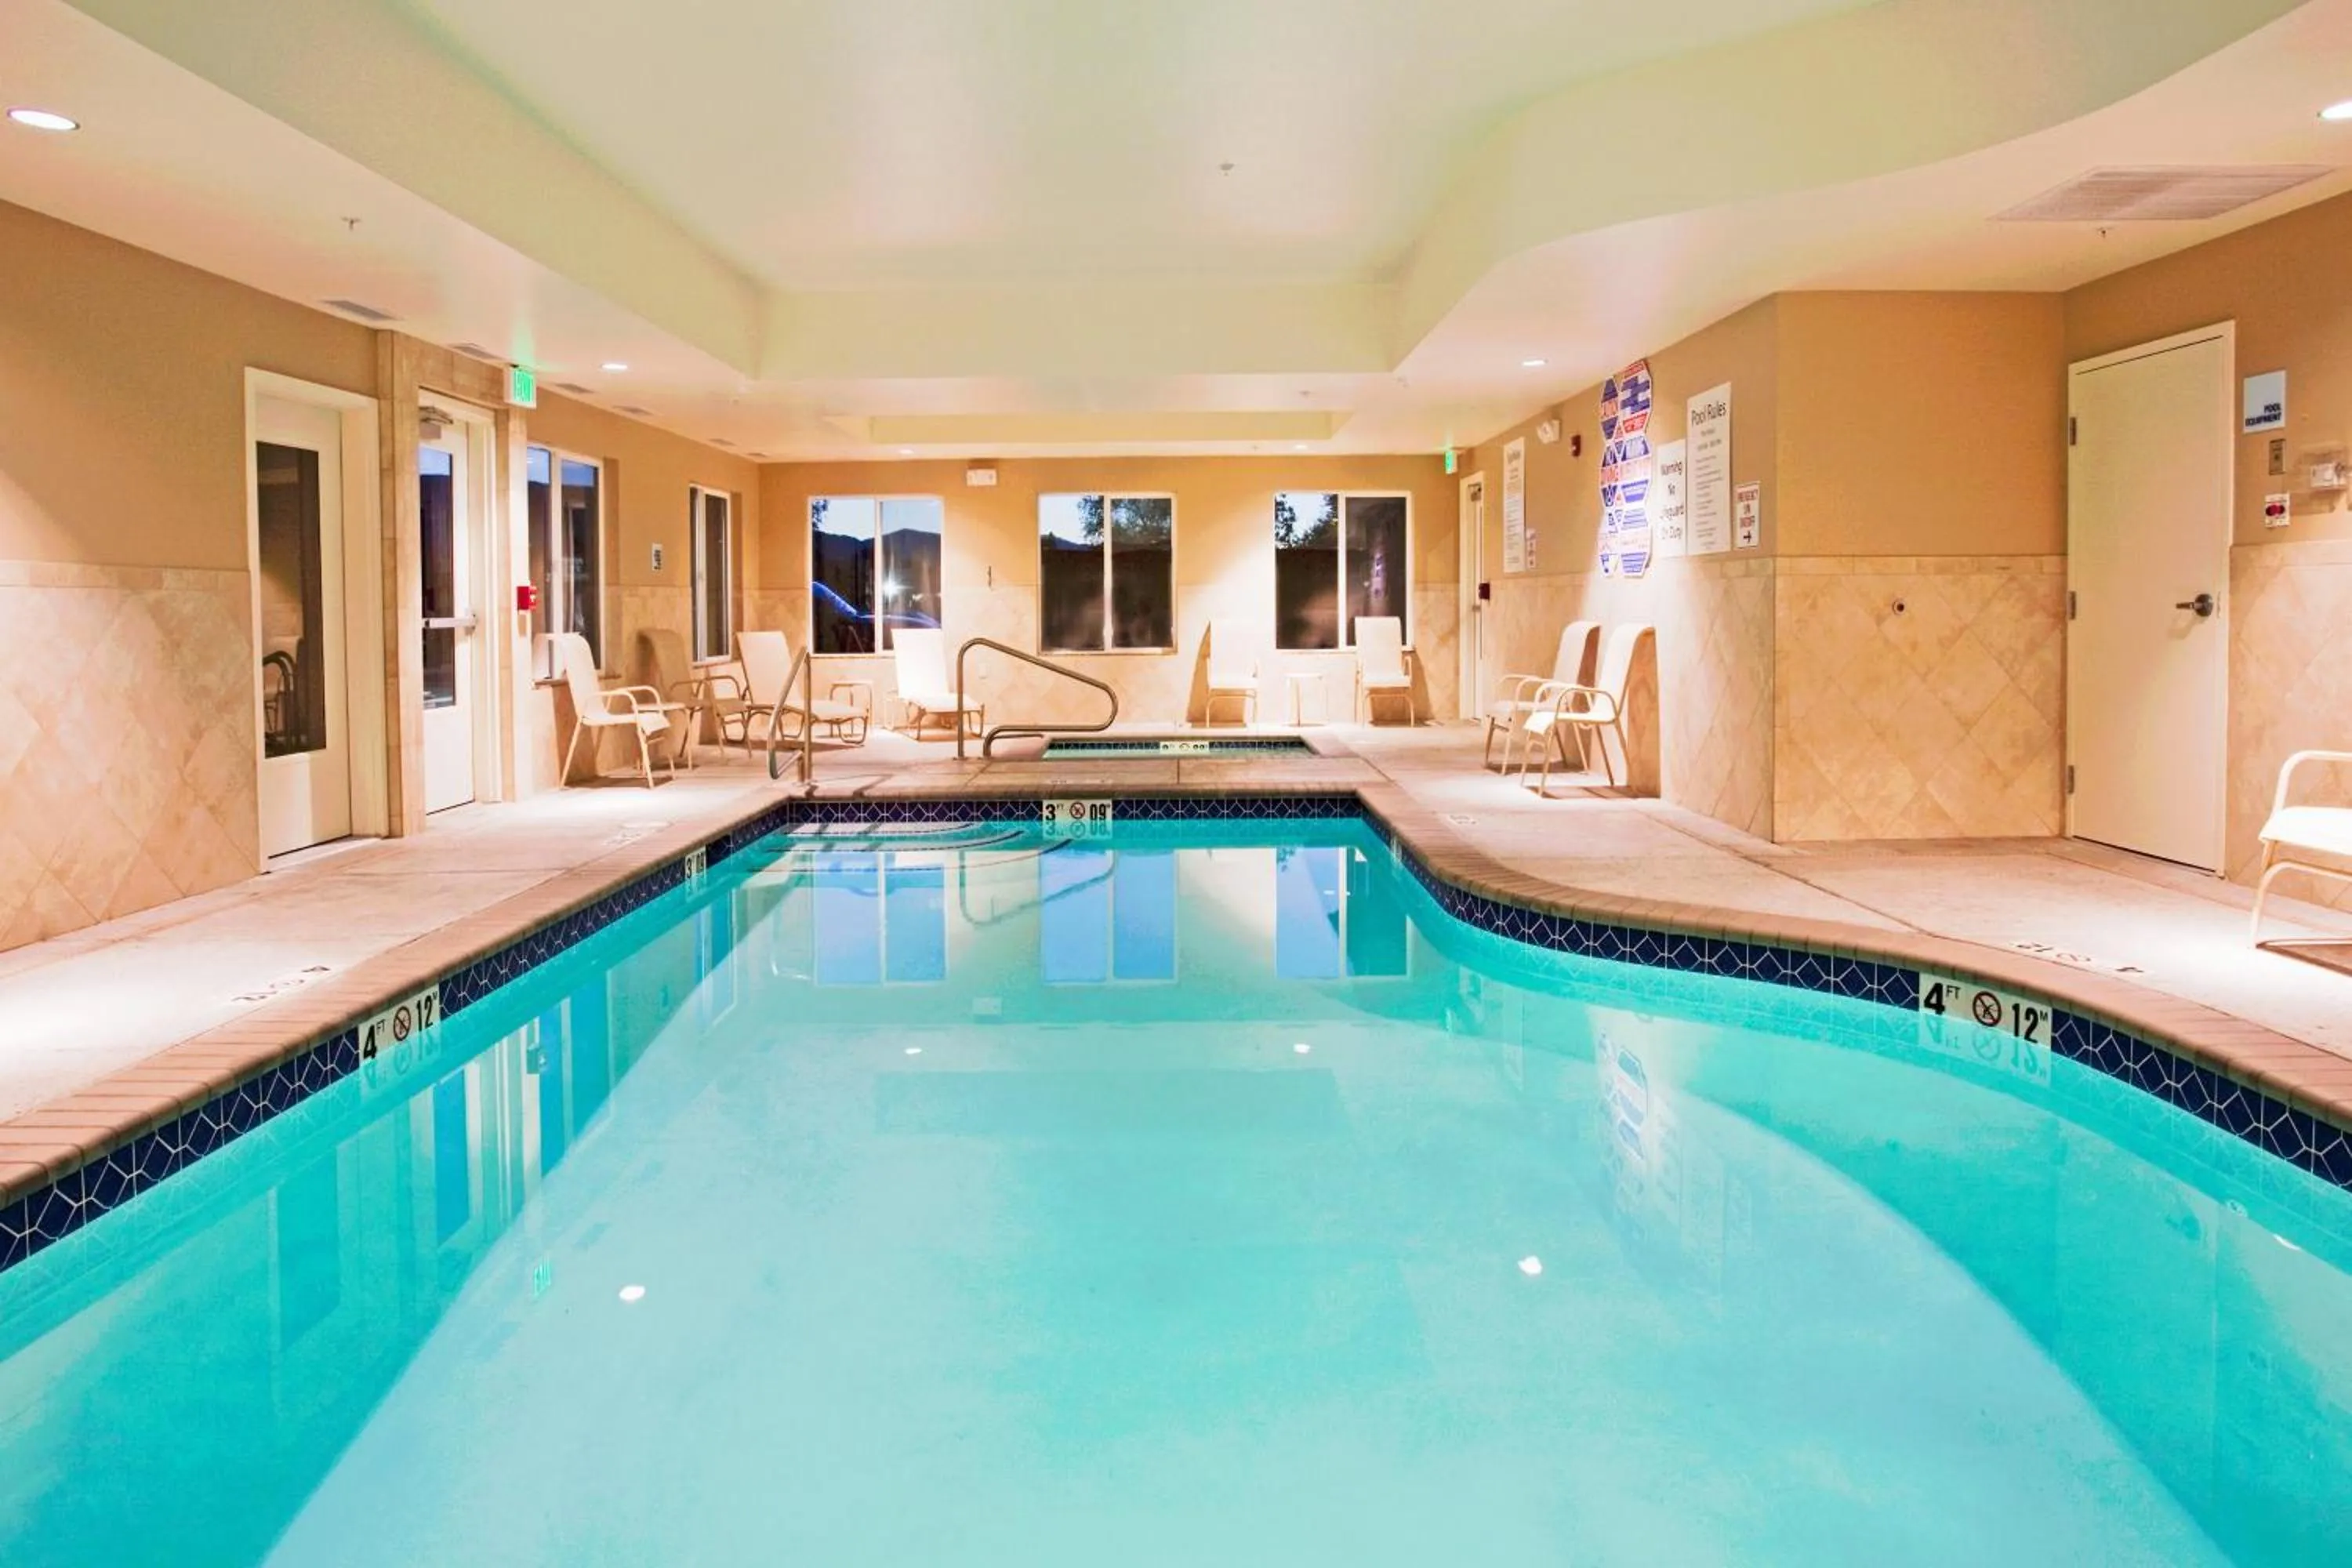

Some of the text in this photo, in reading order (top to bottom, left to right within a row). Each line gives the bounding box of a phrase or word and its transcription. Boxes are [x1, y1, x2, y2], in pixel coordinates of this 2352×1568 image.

[1692, 401, 1727, 428] Pool Rules
[1046, 804, 1056, 821] 3
[363, 1024, 377, 1060] 4
[416, 995, 434, 1033] 12
[1924, 982, 1945, 1014] 4
[2012, 1003, 2038, 1044] 12
